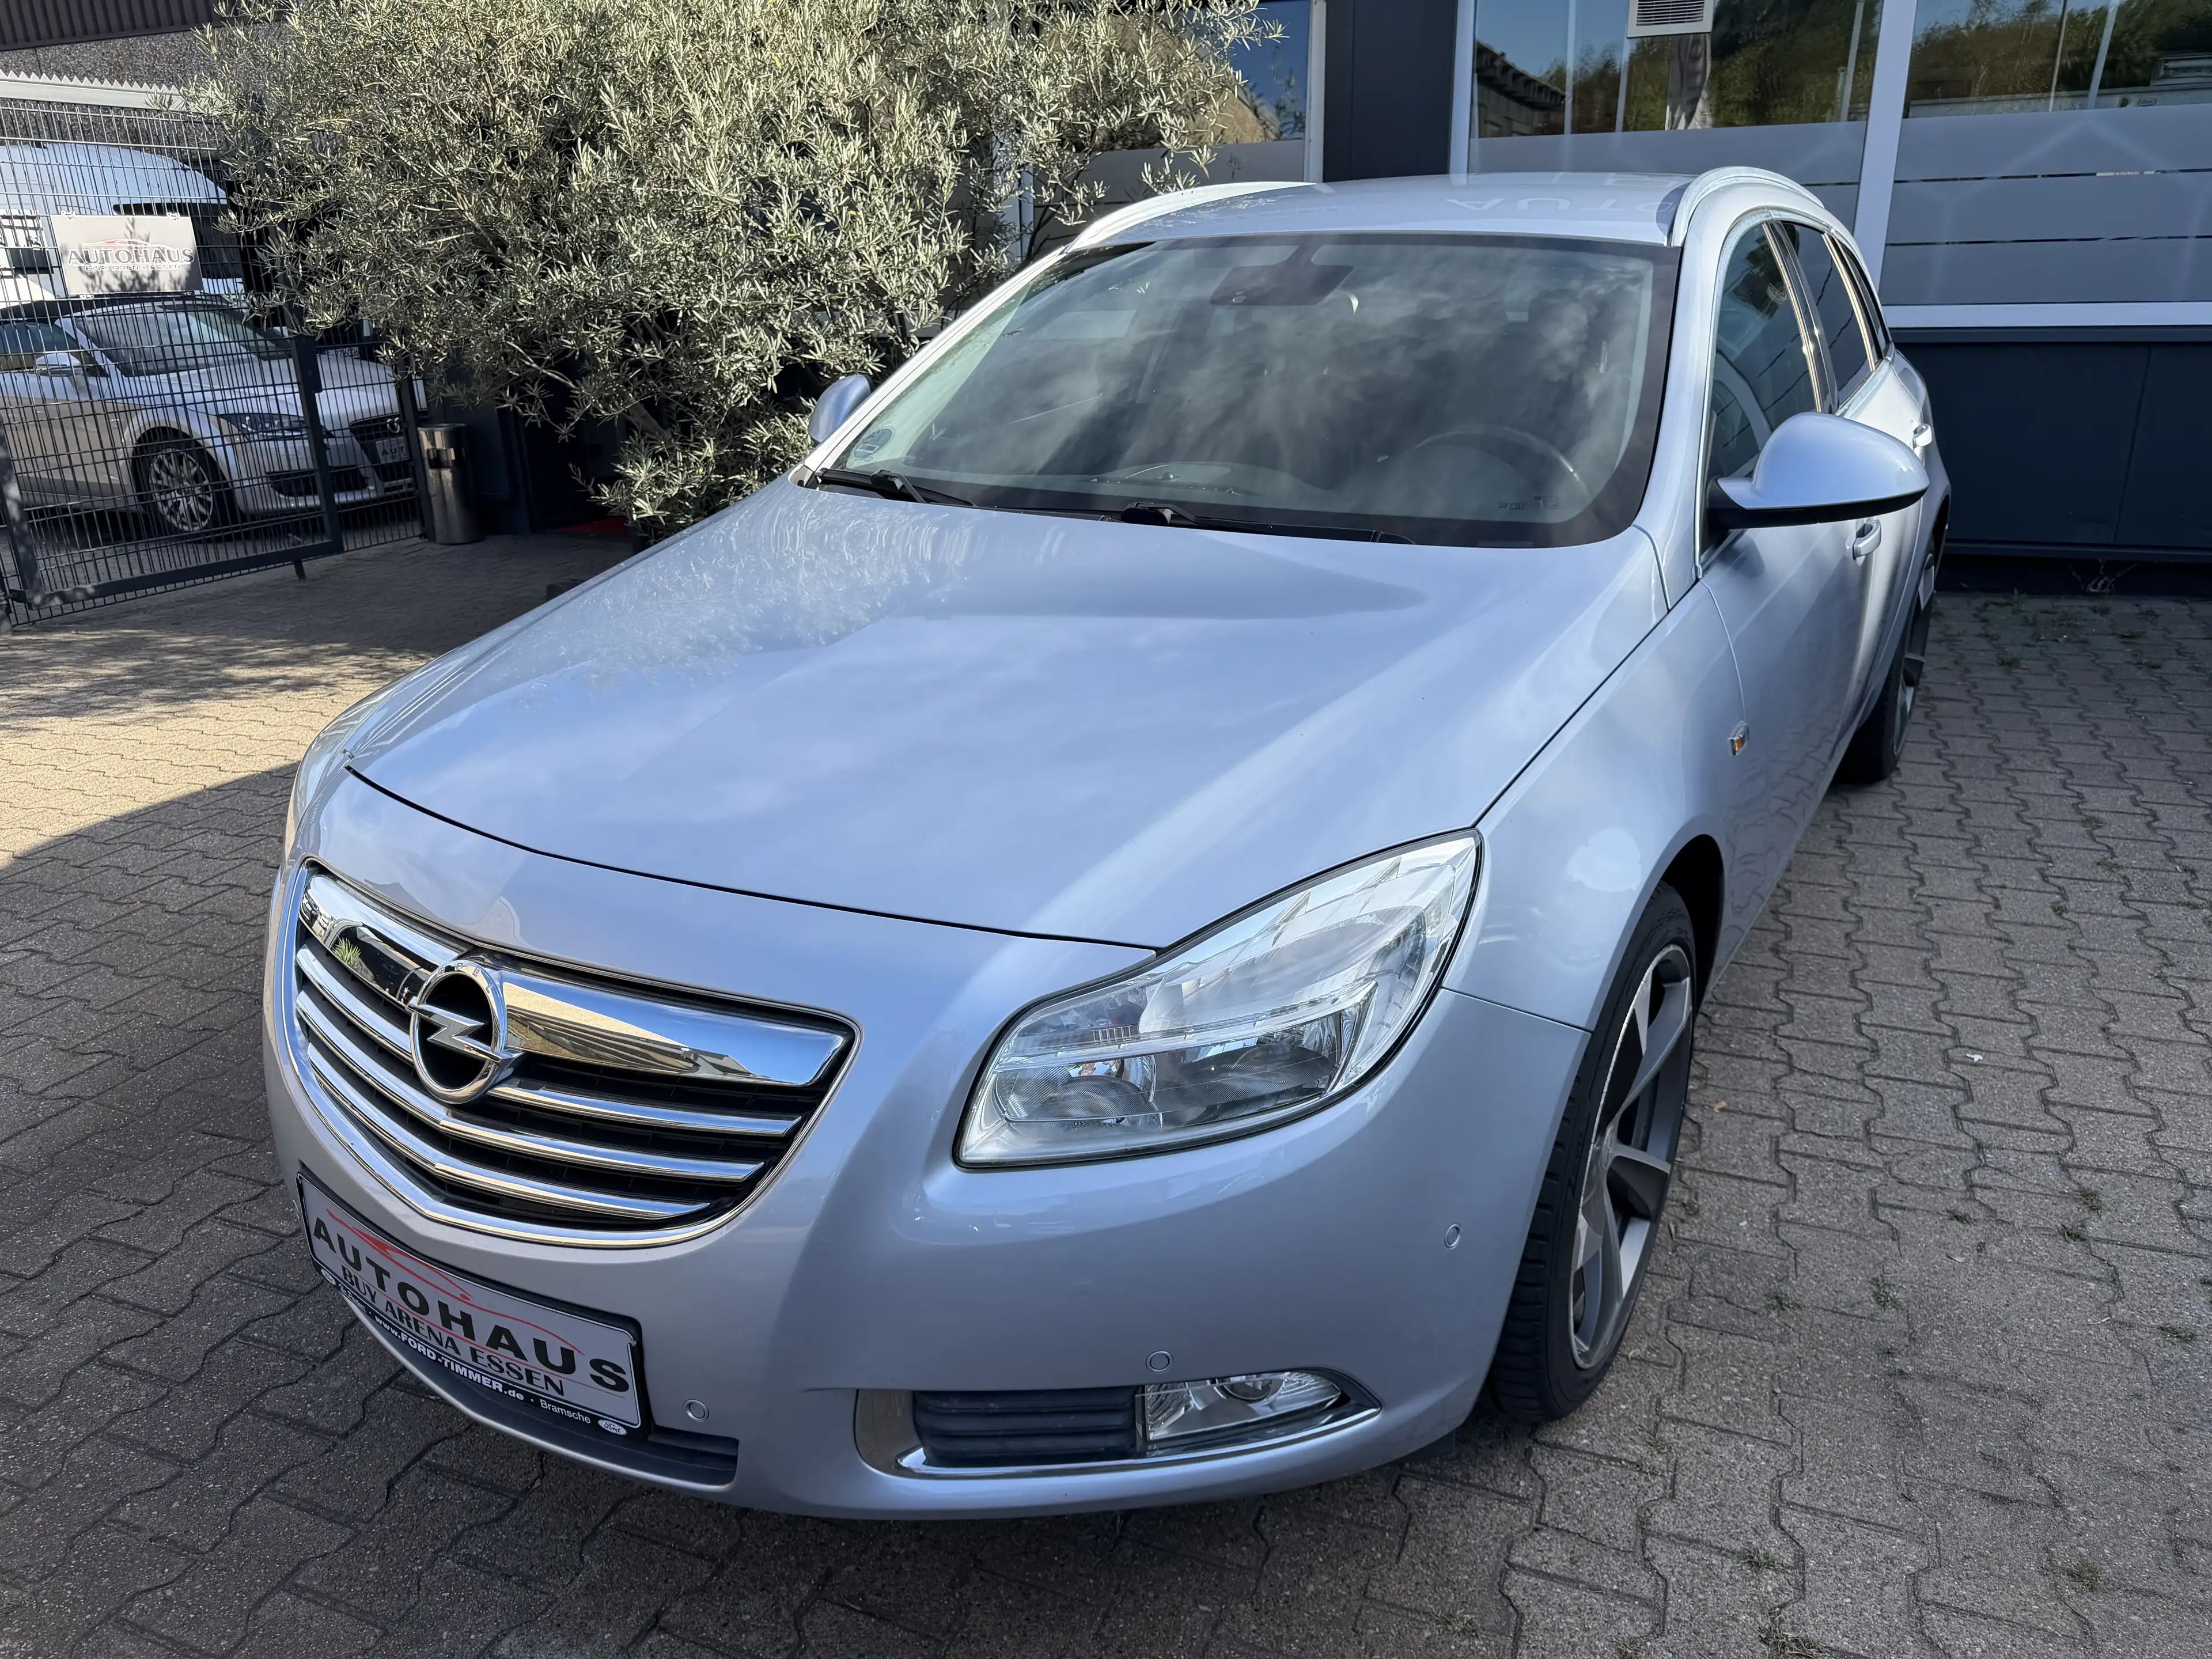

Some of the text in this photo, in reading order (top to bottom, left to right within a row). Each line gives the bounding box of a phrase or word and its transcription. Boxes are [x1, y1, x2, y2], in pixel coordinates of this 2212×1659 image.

[68, 249, 195, 264] AUTOHAUS
[438, 963, 494, 994] OPEL
[314, 1217, 630, 1392] AUTOHAUS
[342, 1265, 565, 1396] BUY ARENA ESSEN
[375, 1316, 525, 1400] www.FORD-TIMMER.de
[540, 1399, 591, 1424] Bramsche
[604, 1422, 621, 1433] Ford
